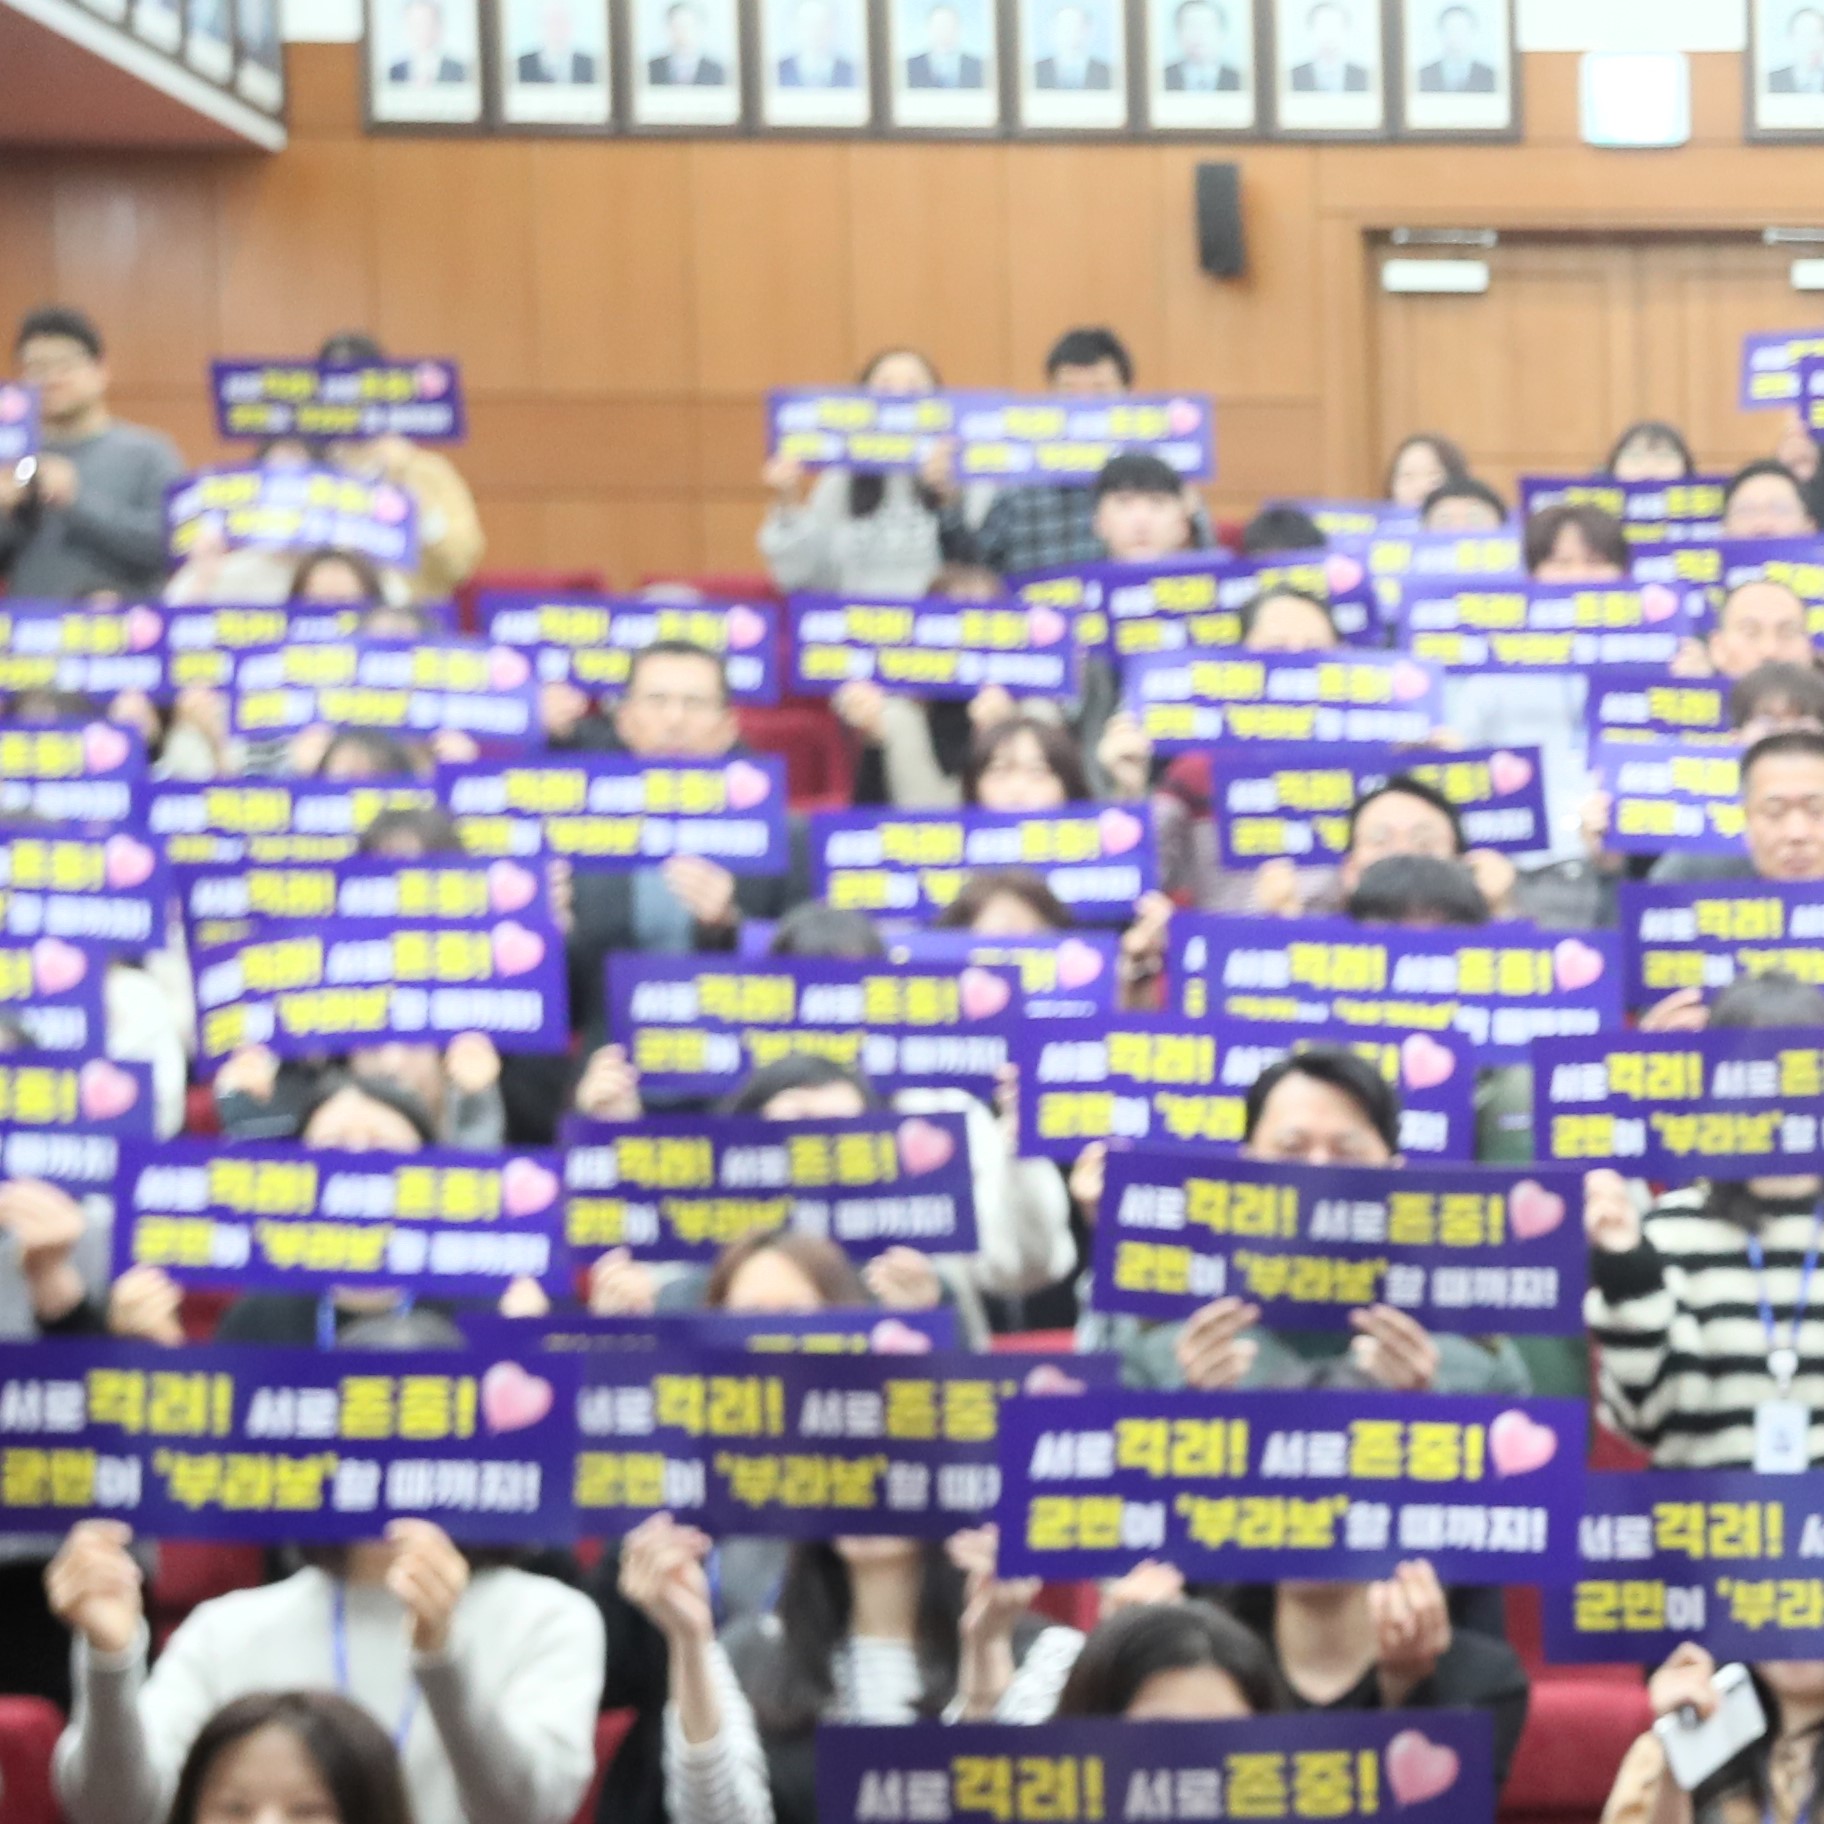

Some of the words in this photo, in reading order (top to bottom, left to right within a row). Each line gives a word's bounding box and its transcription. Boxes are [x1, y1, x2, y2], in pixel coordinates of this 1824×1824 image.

[1030, 1421, 1246, 1475] 서로격려!
[1263, 1422, 1482, 1477] 서로존중!
[1029, 1497, 1162, 1546] 군민이
[1178, 1496, 1389, 1548] '부라보'할
[1401, 1507, 1544, 1549] 때까지!
[1578, 1502, 1784, 1557] 서로격려!
[1573, 1581, 1706, 1629] 군민이
[856, 1755, 1104, 1821] 서로격려!
[1126, 1751, 1376, 1817] 서로존중!
